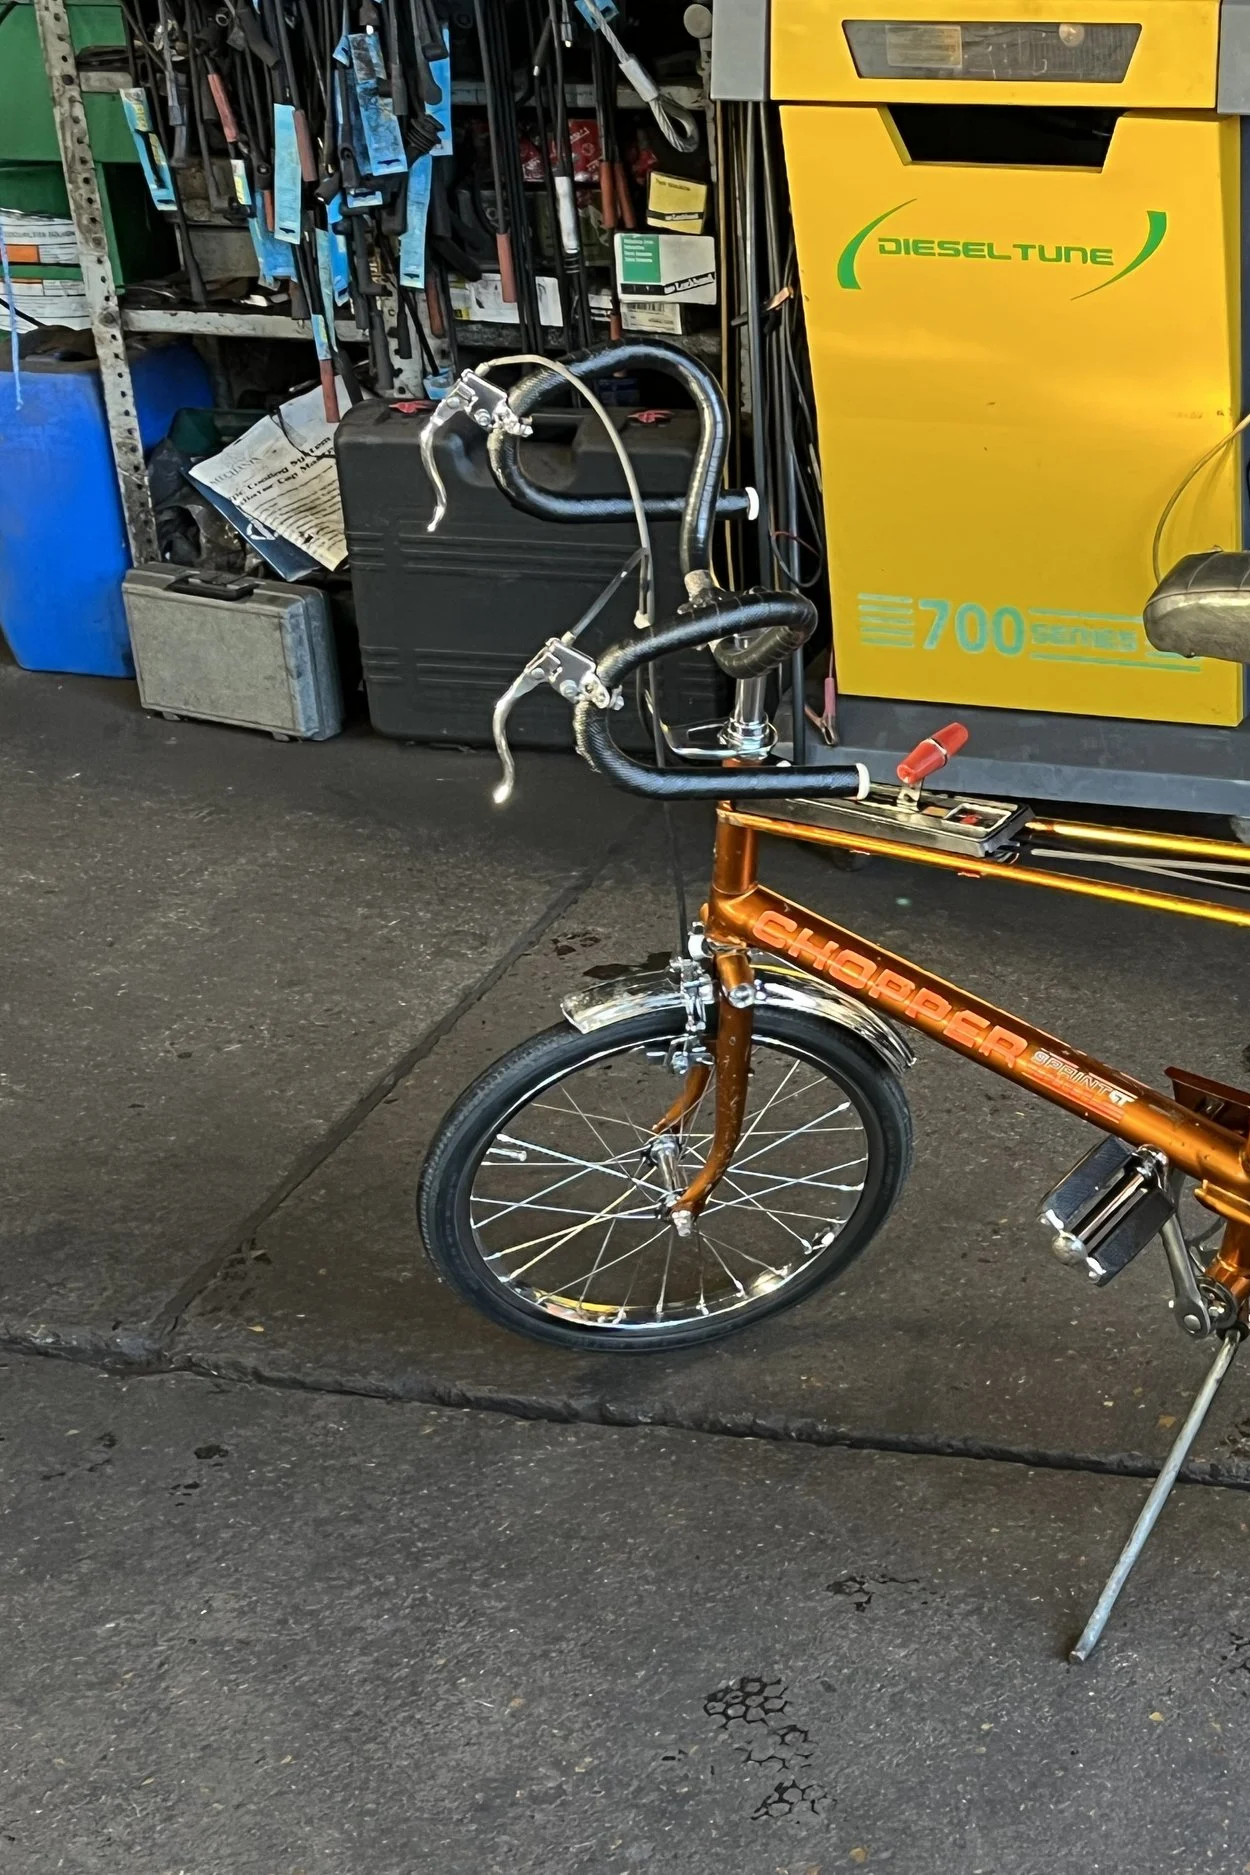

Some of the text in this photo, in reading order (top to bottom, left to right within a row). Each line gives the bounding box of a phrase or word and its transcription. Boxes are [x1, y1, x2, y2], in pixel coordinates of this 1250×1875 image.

[917, 598, 1026, 657] 700
[752, 910, 1028, 1069] CHOPPER
[1030, 1050, 1114, 1098] SPRINT
